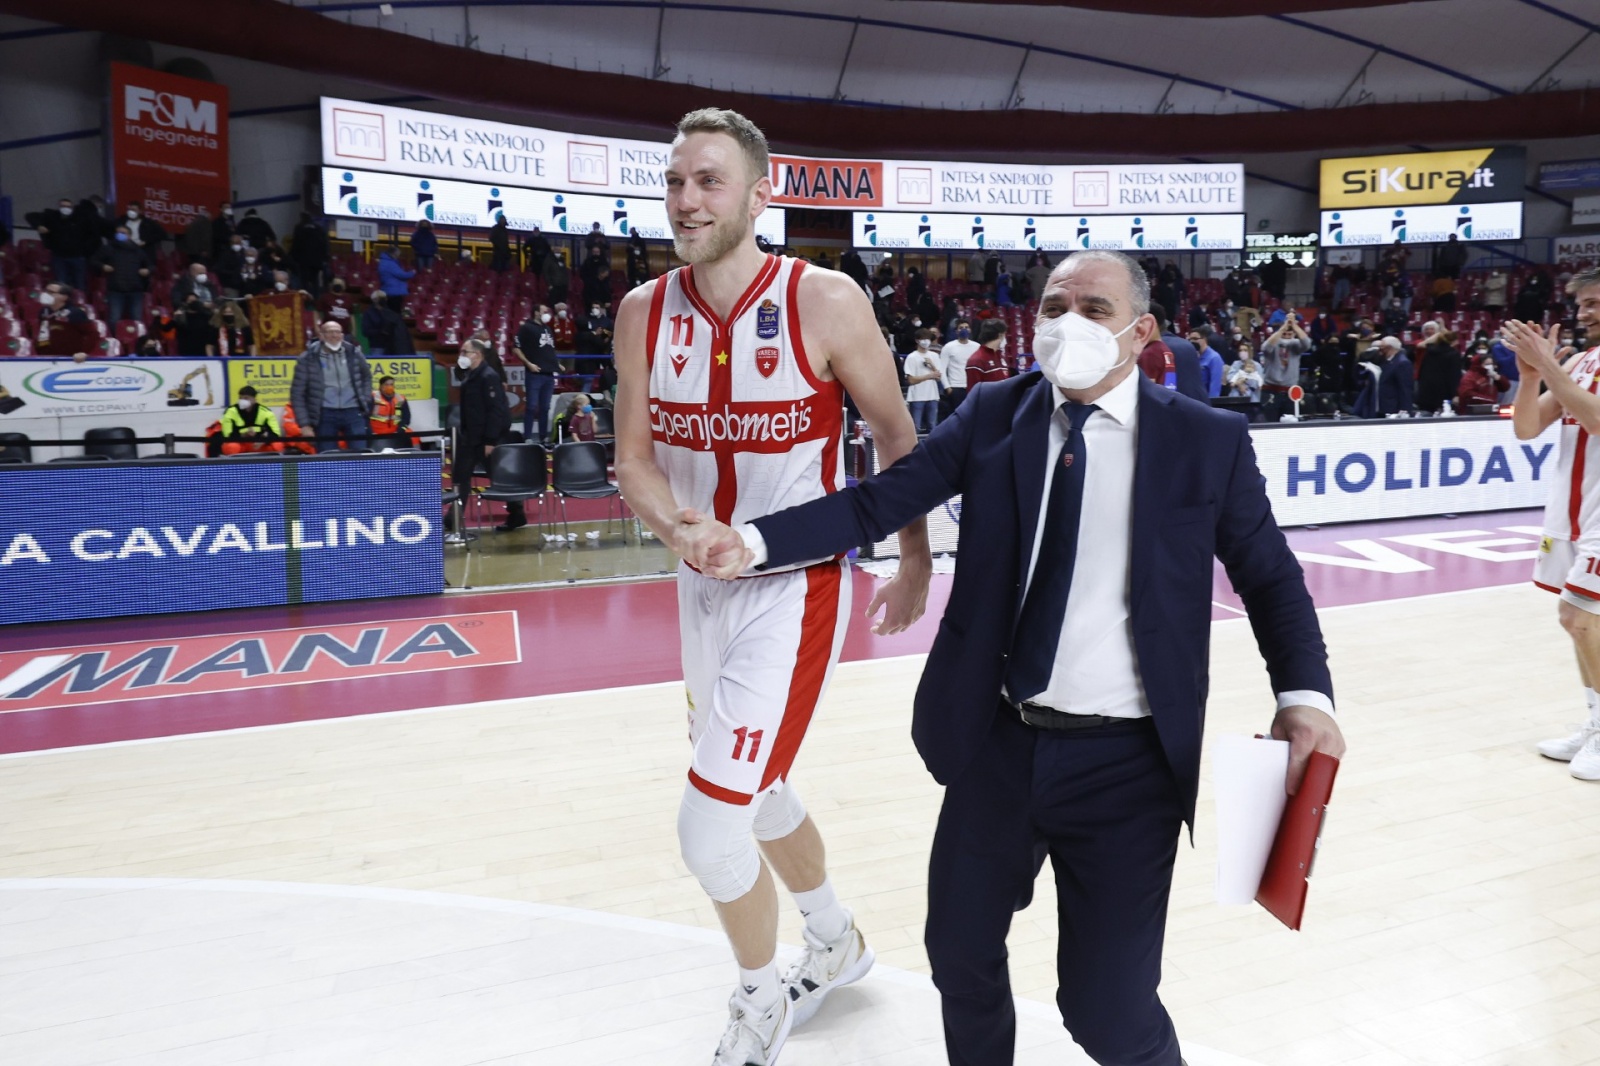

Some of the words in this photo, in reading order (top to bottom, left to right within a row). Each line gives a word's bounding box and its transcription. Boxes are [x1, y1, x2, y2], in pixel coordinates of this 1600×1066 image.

[125, 85, 217, 134] F&M
[125, 121, 218, 149] ingegneria
[398, 119, 458, 142] INTESA
[464, 129, 545, 153] SANPAOLO
[400, 140, 455, 166] RBM
[463, 148, 546, 177] SALUTE
[619, 148, 668, 166] INTESA
[620, 166, 665, 187] RBM
[941, 170, 985, 185] INTESA
[989, 171, 1053, 186] SANPAOLO
[1118, 172, 1165, 185] INTESA
[1169, 171, 1237, 185] SANPAOLO
[144, 186, 170, 200] THE
[942, 186, 982, 203] RBM
[987, 187, 1053, 205] SALUTE
[1119, 187, 1161, 204] RBM
[1166, 187, 1237, 204] SALUTE
[759, 315, 777, 323] LBA
[670, 314, 694, 347] 11
[243, 363, 287, 378] F.LLI
[390, 362, 421, 375] SRL
[1287, 443, 1554, 497] HOLIDAY
[70, 514, 432, 562] CAVALLINO
[0, 621, 479, 699] MANA
[731, 726, 764, 763] 11
